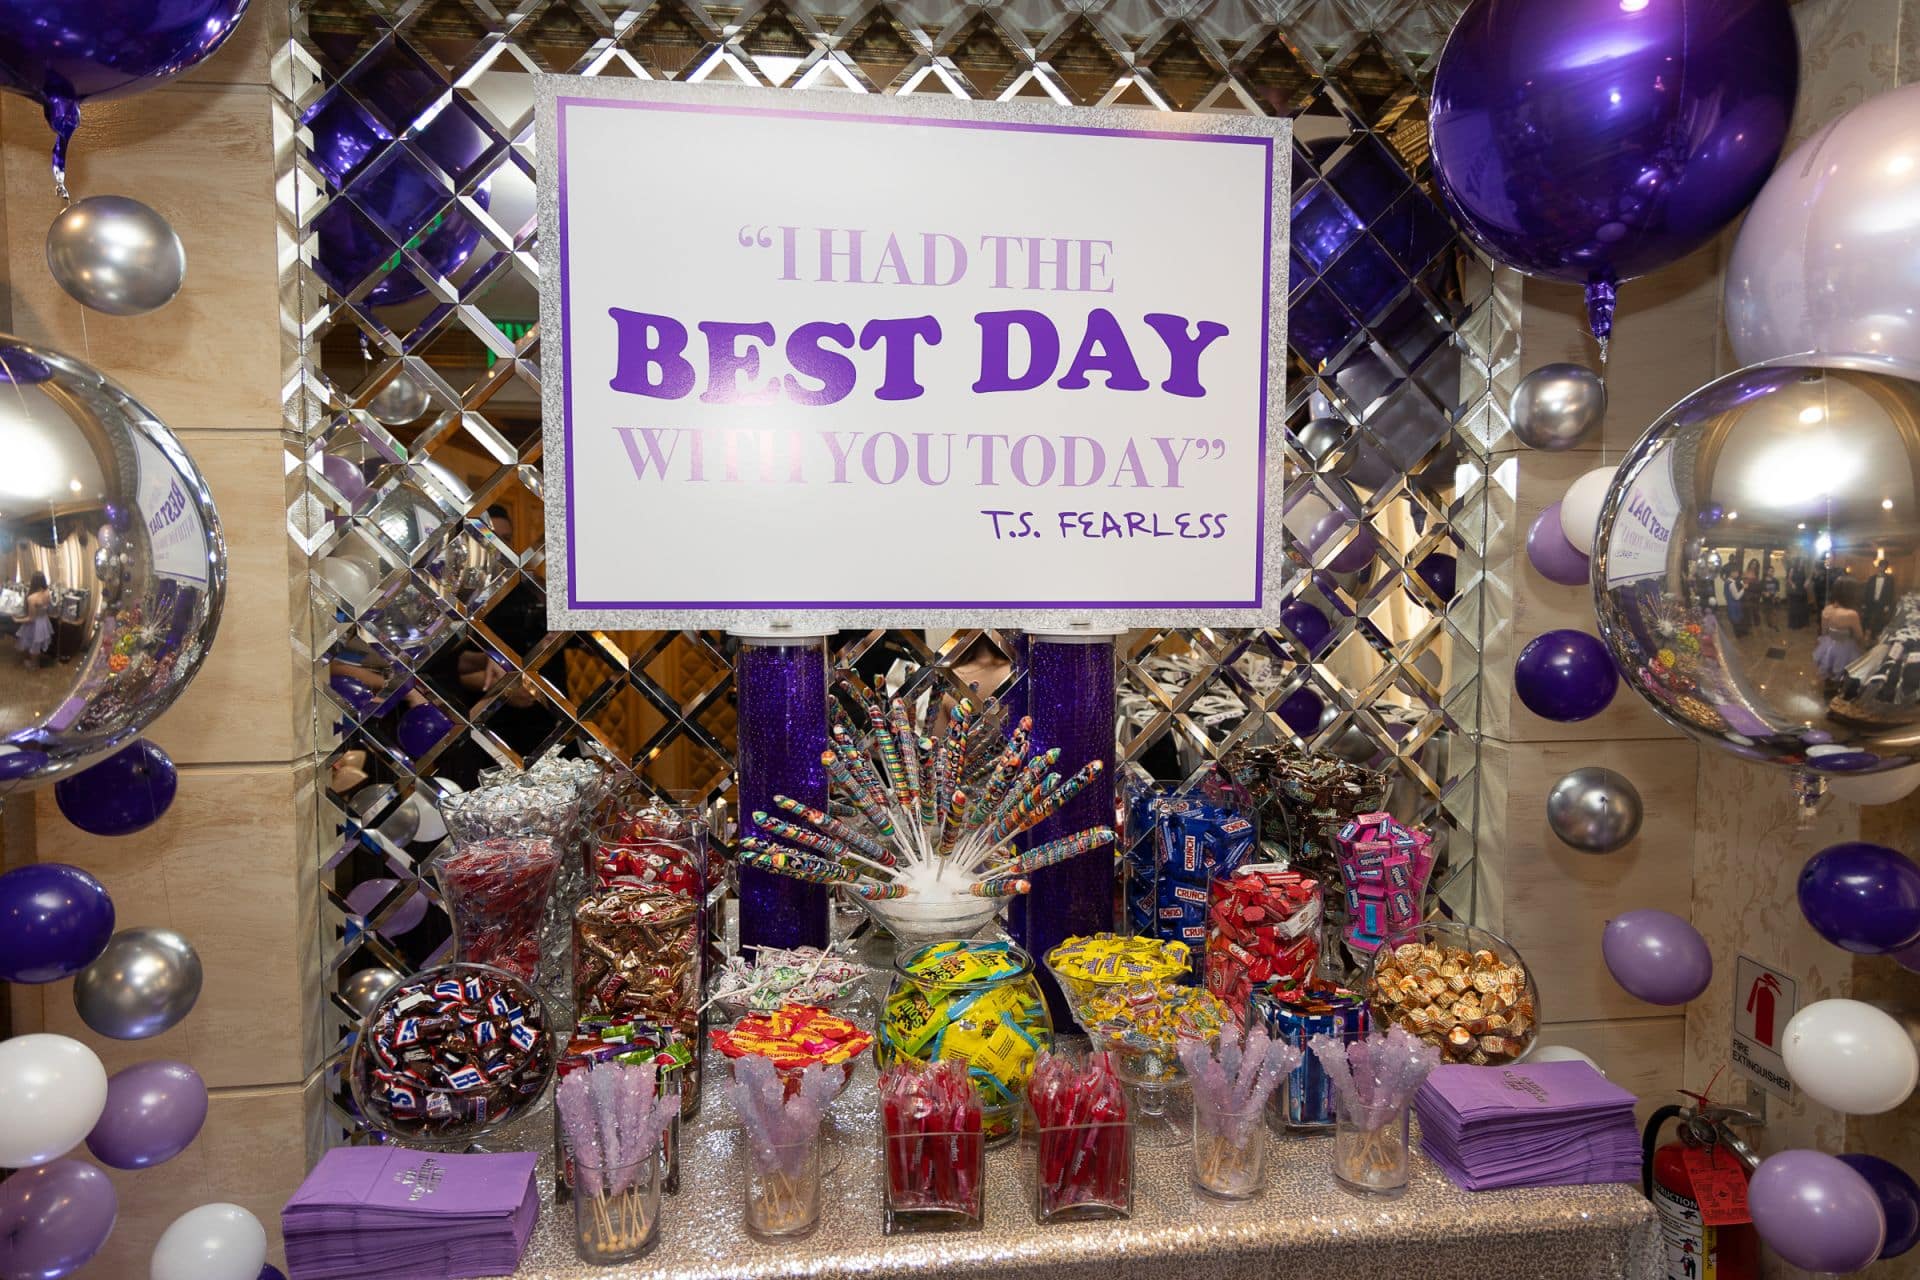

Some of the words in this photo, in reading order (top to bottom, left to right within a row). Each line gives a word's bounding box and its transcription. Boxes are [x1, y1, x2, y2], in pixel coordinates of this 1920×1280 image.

[813, 228, 968, 286] HAD
[980, 234, 1114, 293] THE
[608, 307, 943, 405] BEST
[972, 308, 1229, 397] DAY
[612, 427, 808, 484] WITH
[820, 431, 959, 486] YOU
[981, 511, 1040, 539] T.S.
[1059, 511, 1228, 539] FEARLESS
[1185, 836, 1195, 871] CRUNCH
[1733, 1039, 1749, 1056] FIRE
[1733, 1050, 1790, 1091] EXTINGUISHER
